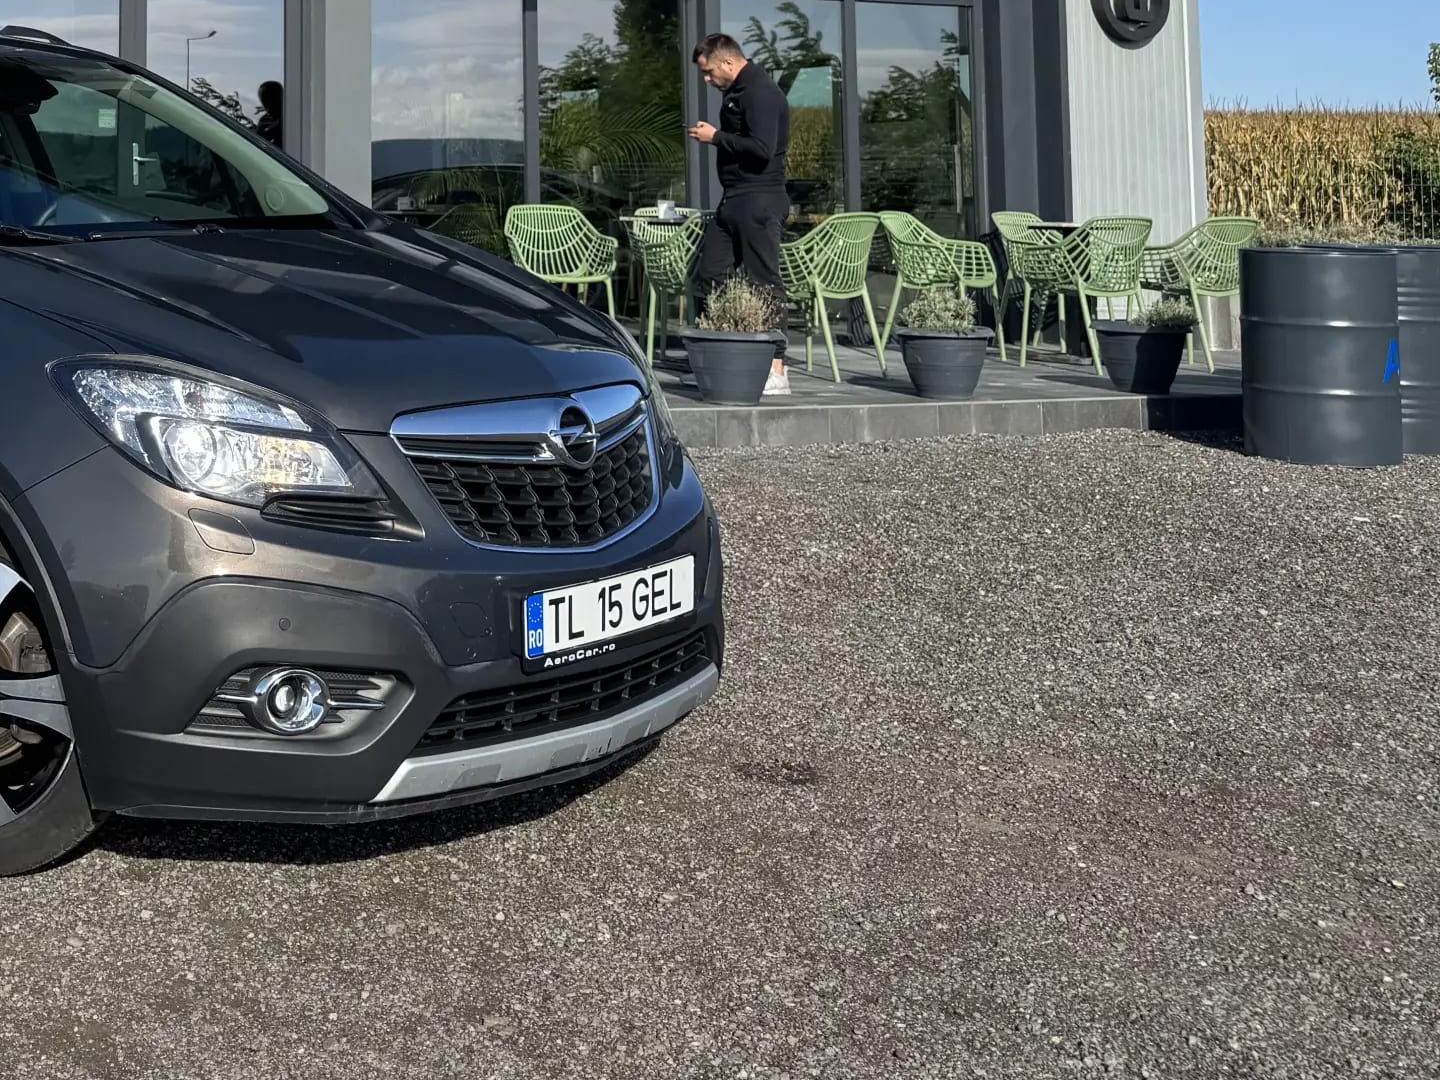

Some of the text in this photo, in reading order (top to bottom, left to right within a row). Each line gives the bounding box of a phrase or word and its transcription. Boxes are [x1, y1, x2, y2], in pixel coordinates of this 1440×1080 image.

[549, 568, 682, 644] TL 15 GEL
[528, 628, 543, 650] RO
[543, 643, 617, 668] AeroCar.ro
